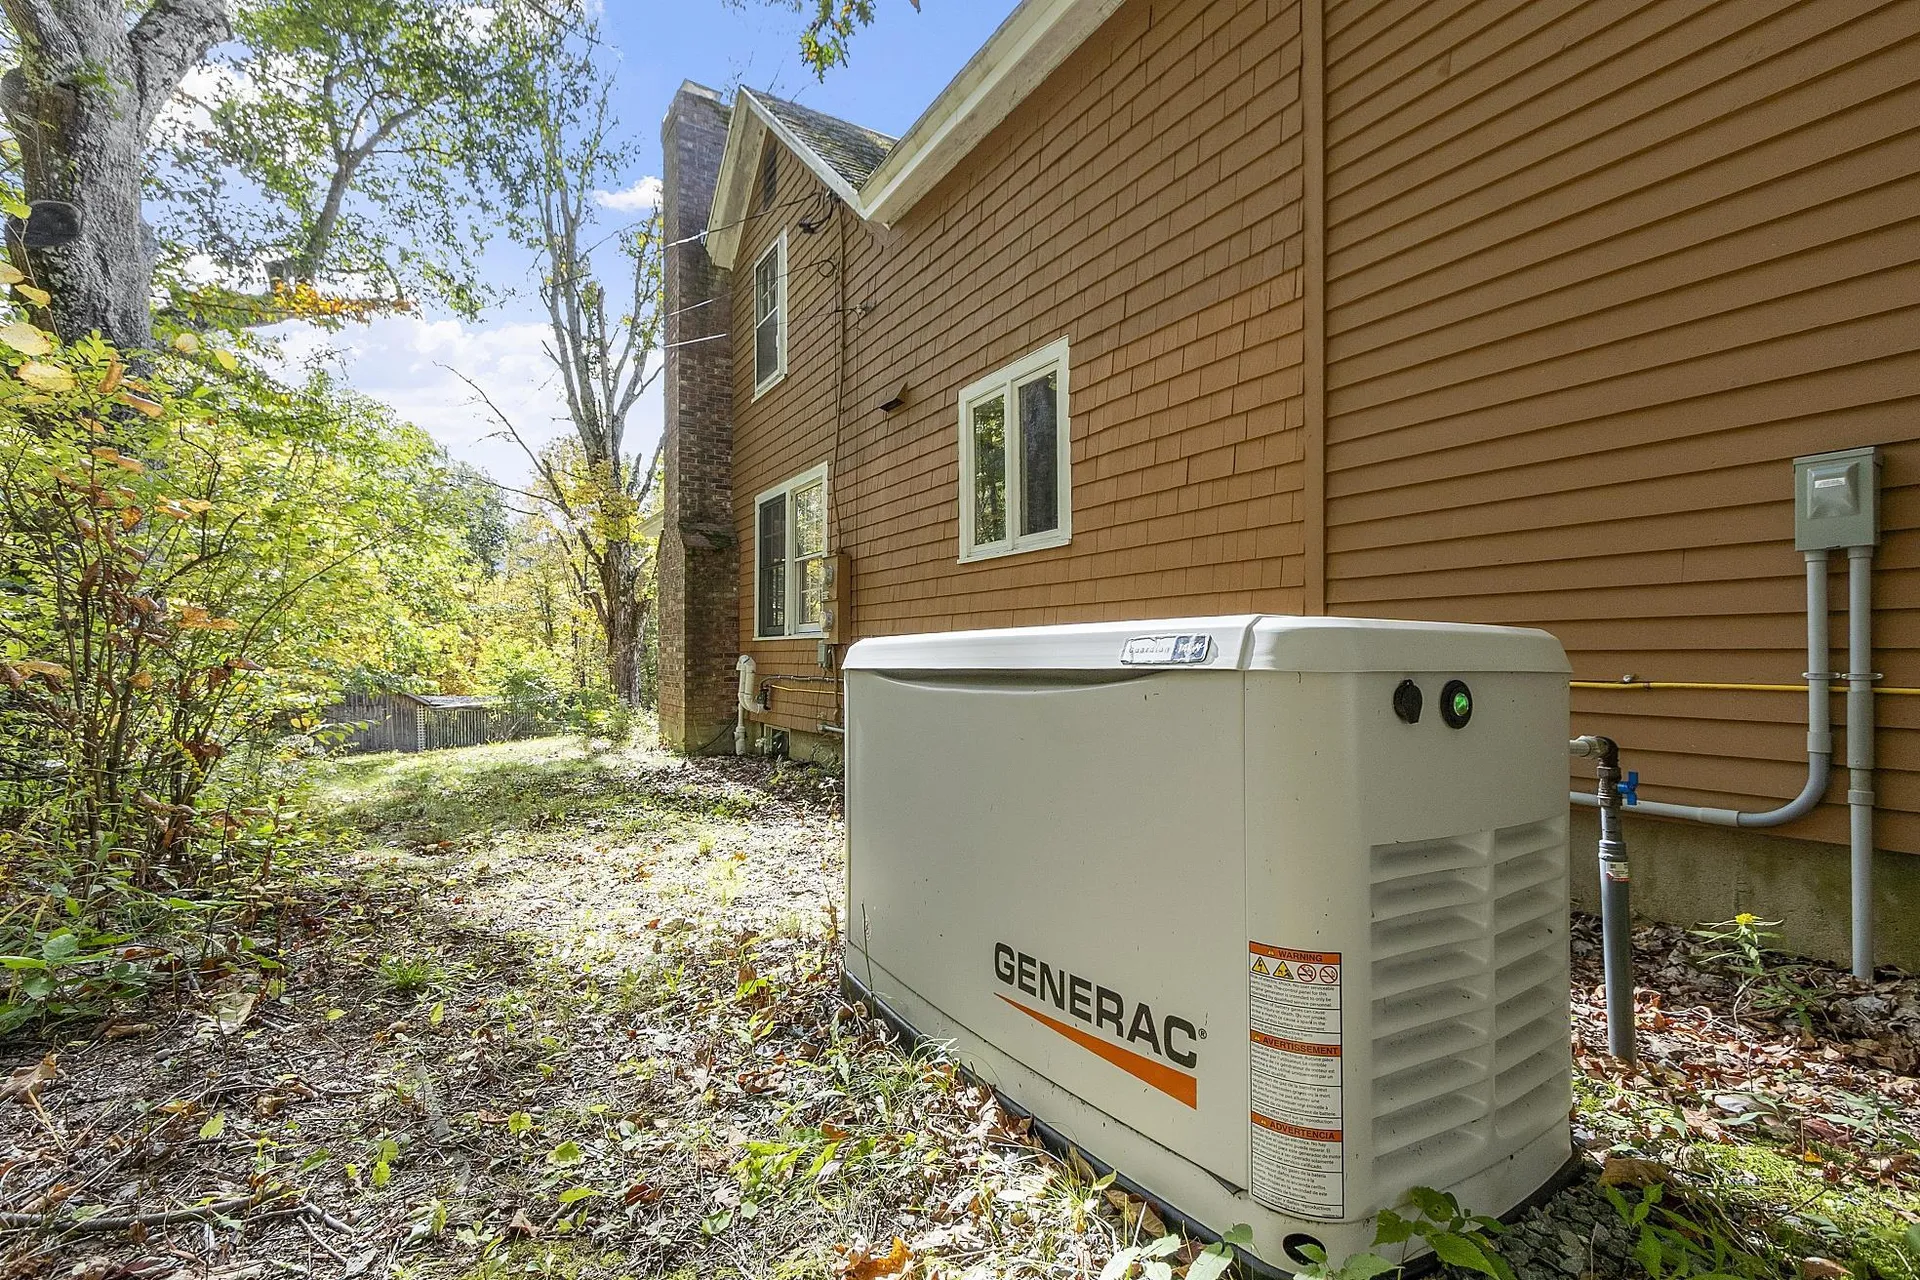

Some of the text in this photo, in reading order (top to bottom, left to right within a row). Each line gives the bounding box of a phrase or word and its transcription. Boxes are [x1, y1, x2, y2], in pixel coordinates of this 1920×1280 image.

[1278, 950, 1322, 963] WARNING
[994, 942, 1197, 1069] GENERAC
[1263, 1037, 1338, 1055] AVERTISSEMENT
[1269, 1121, 1335, 1140] ADVERTENCIA
